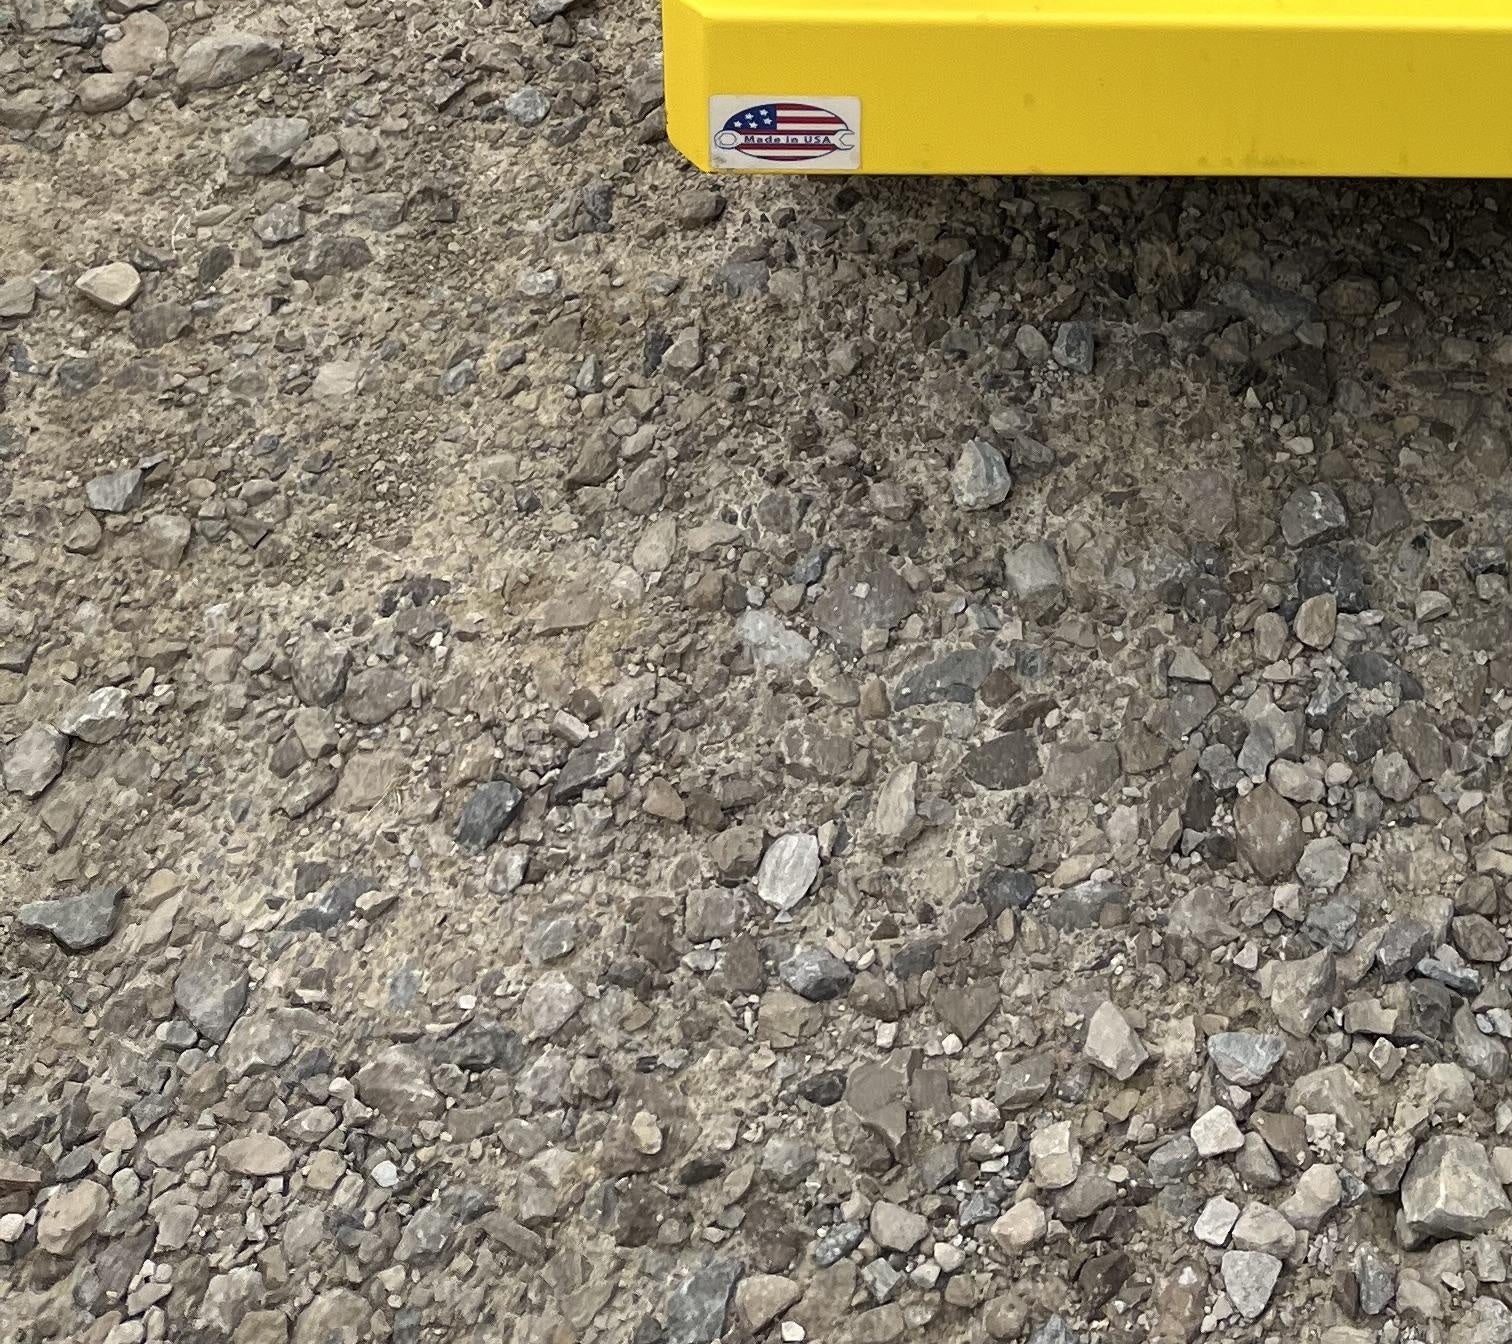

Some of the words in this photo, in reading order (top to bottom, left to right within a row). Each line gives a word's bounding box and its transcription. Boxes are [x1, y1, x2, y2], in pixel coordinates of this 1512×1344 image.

[744, 135, 781, 144] Made
[785, 135, 799, 144] in
[804, 135, 832, 144] USA
